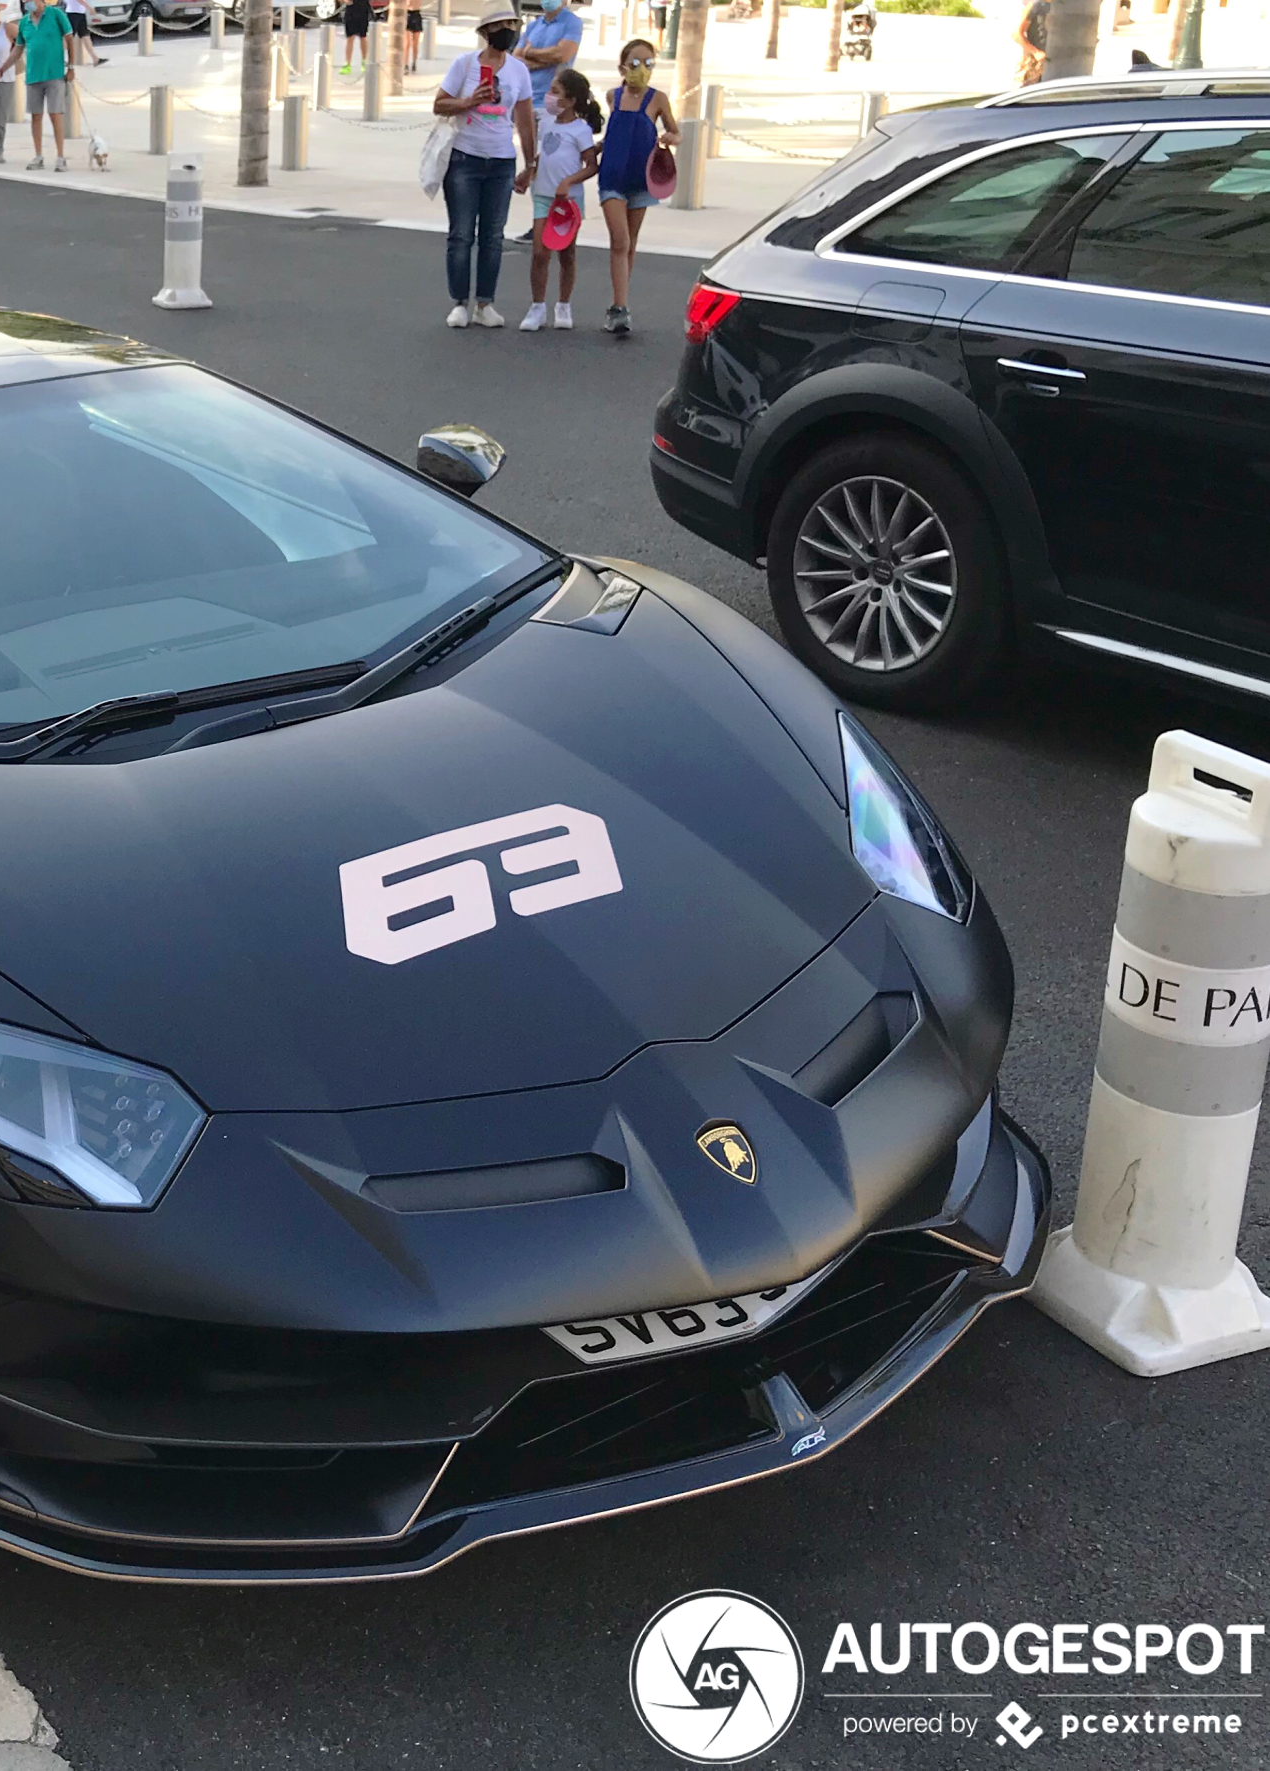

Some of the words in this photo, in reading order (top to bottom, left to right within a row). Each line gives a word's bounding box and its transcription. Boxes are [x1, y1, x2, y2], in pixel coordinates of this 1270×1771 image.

[339, 803, 613, 965] 63
[1119, 962, 1180, 1022] DE
[1203, 986, 1270, 1028] PA
